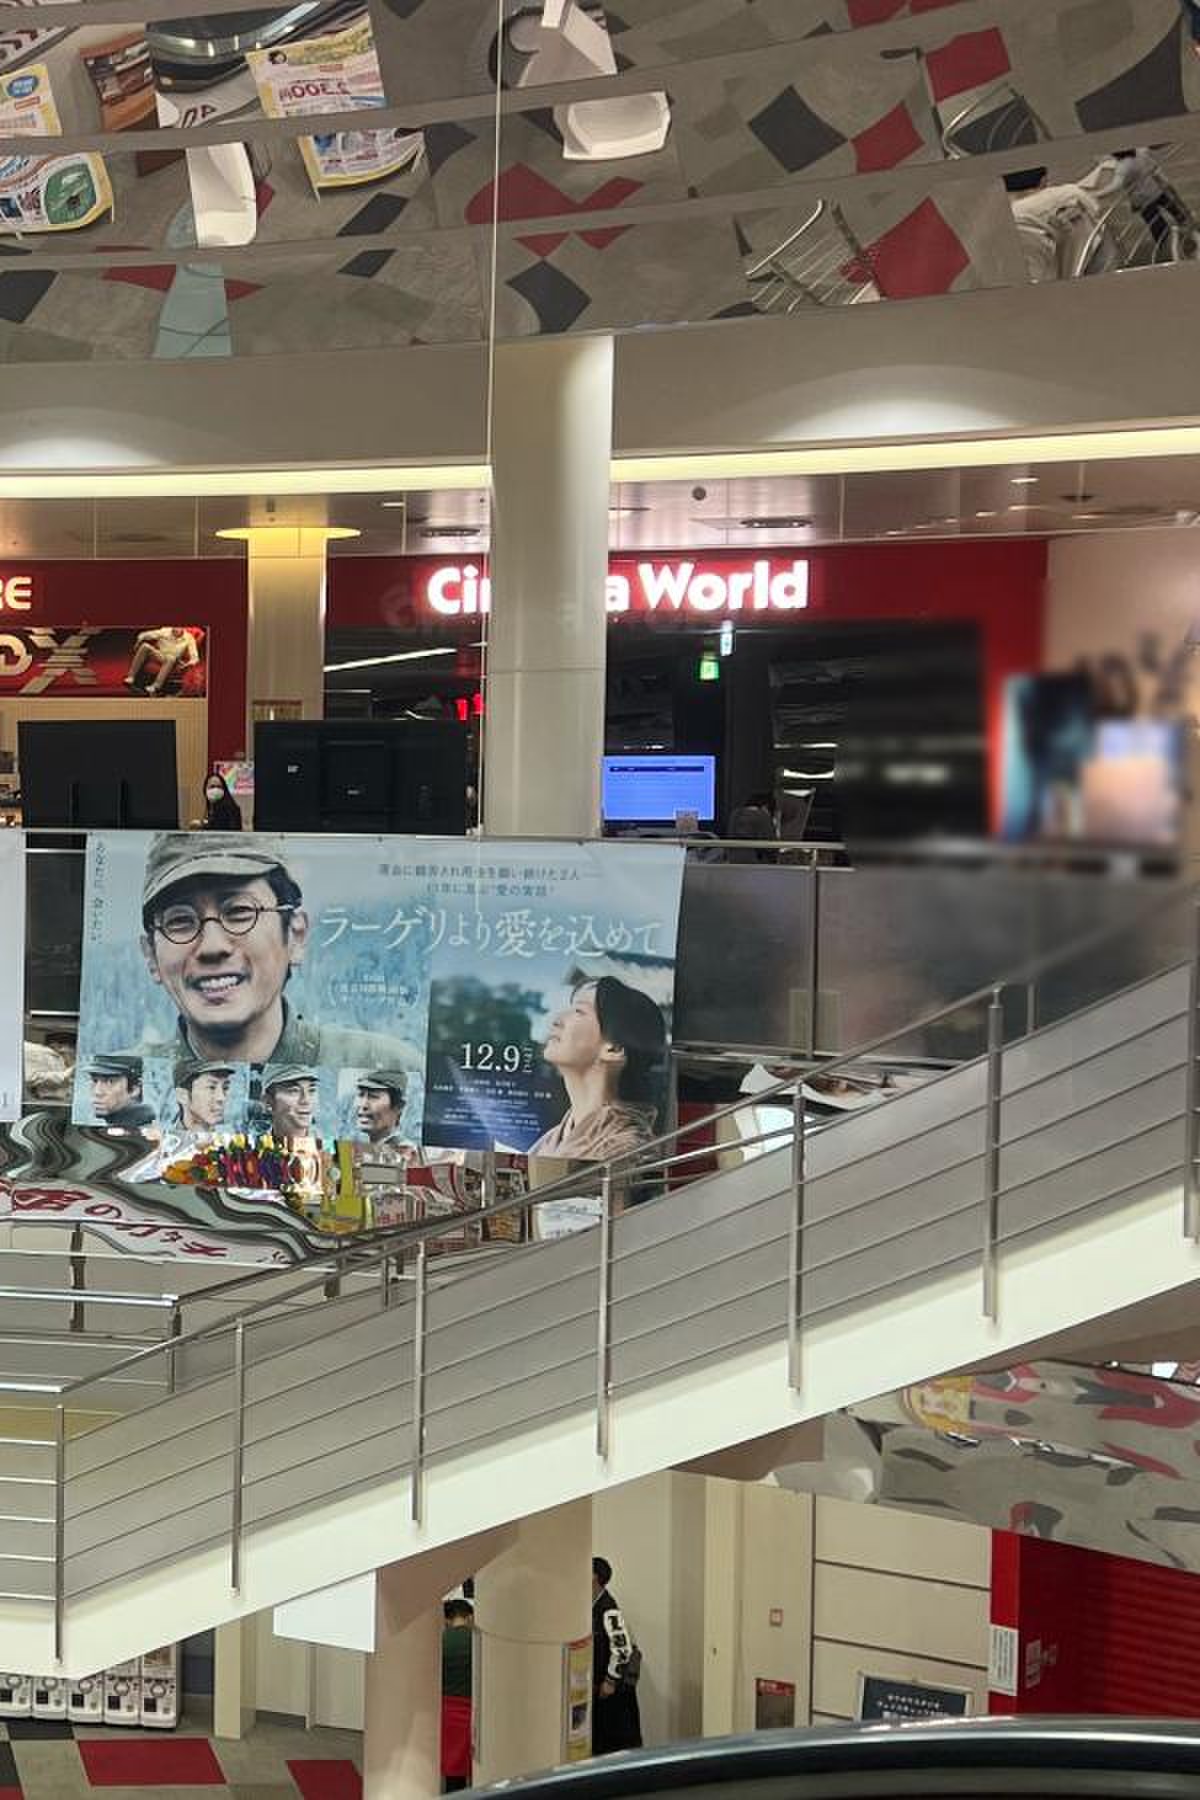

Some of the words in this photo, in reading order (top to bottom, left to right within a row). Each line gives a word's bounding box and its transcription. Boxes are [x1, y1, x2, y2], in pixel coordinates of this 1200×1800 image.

[427, 563, 629, 614] Cia
[638, 559, 809, 611] World
[319, 904, 664, 959] ラーゲリより愛を込めて
[459, 1042, 521, 1073] 12.9
